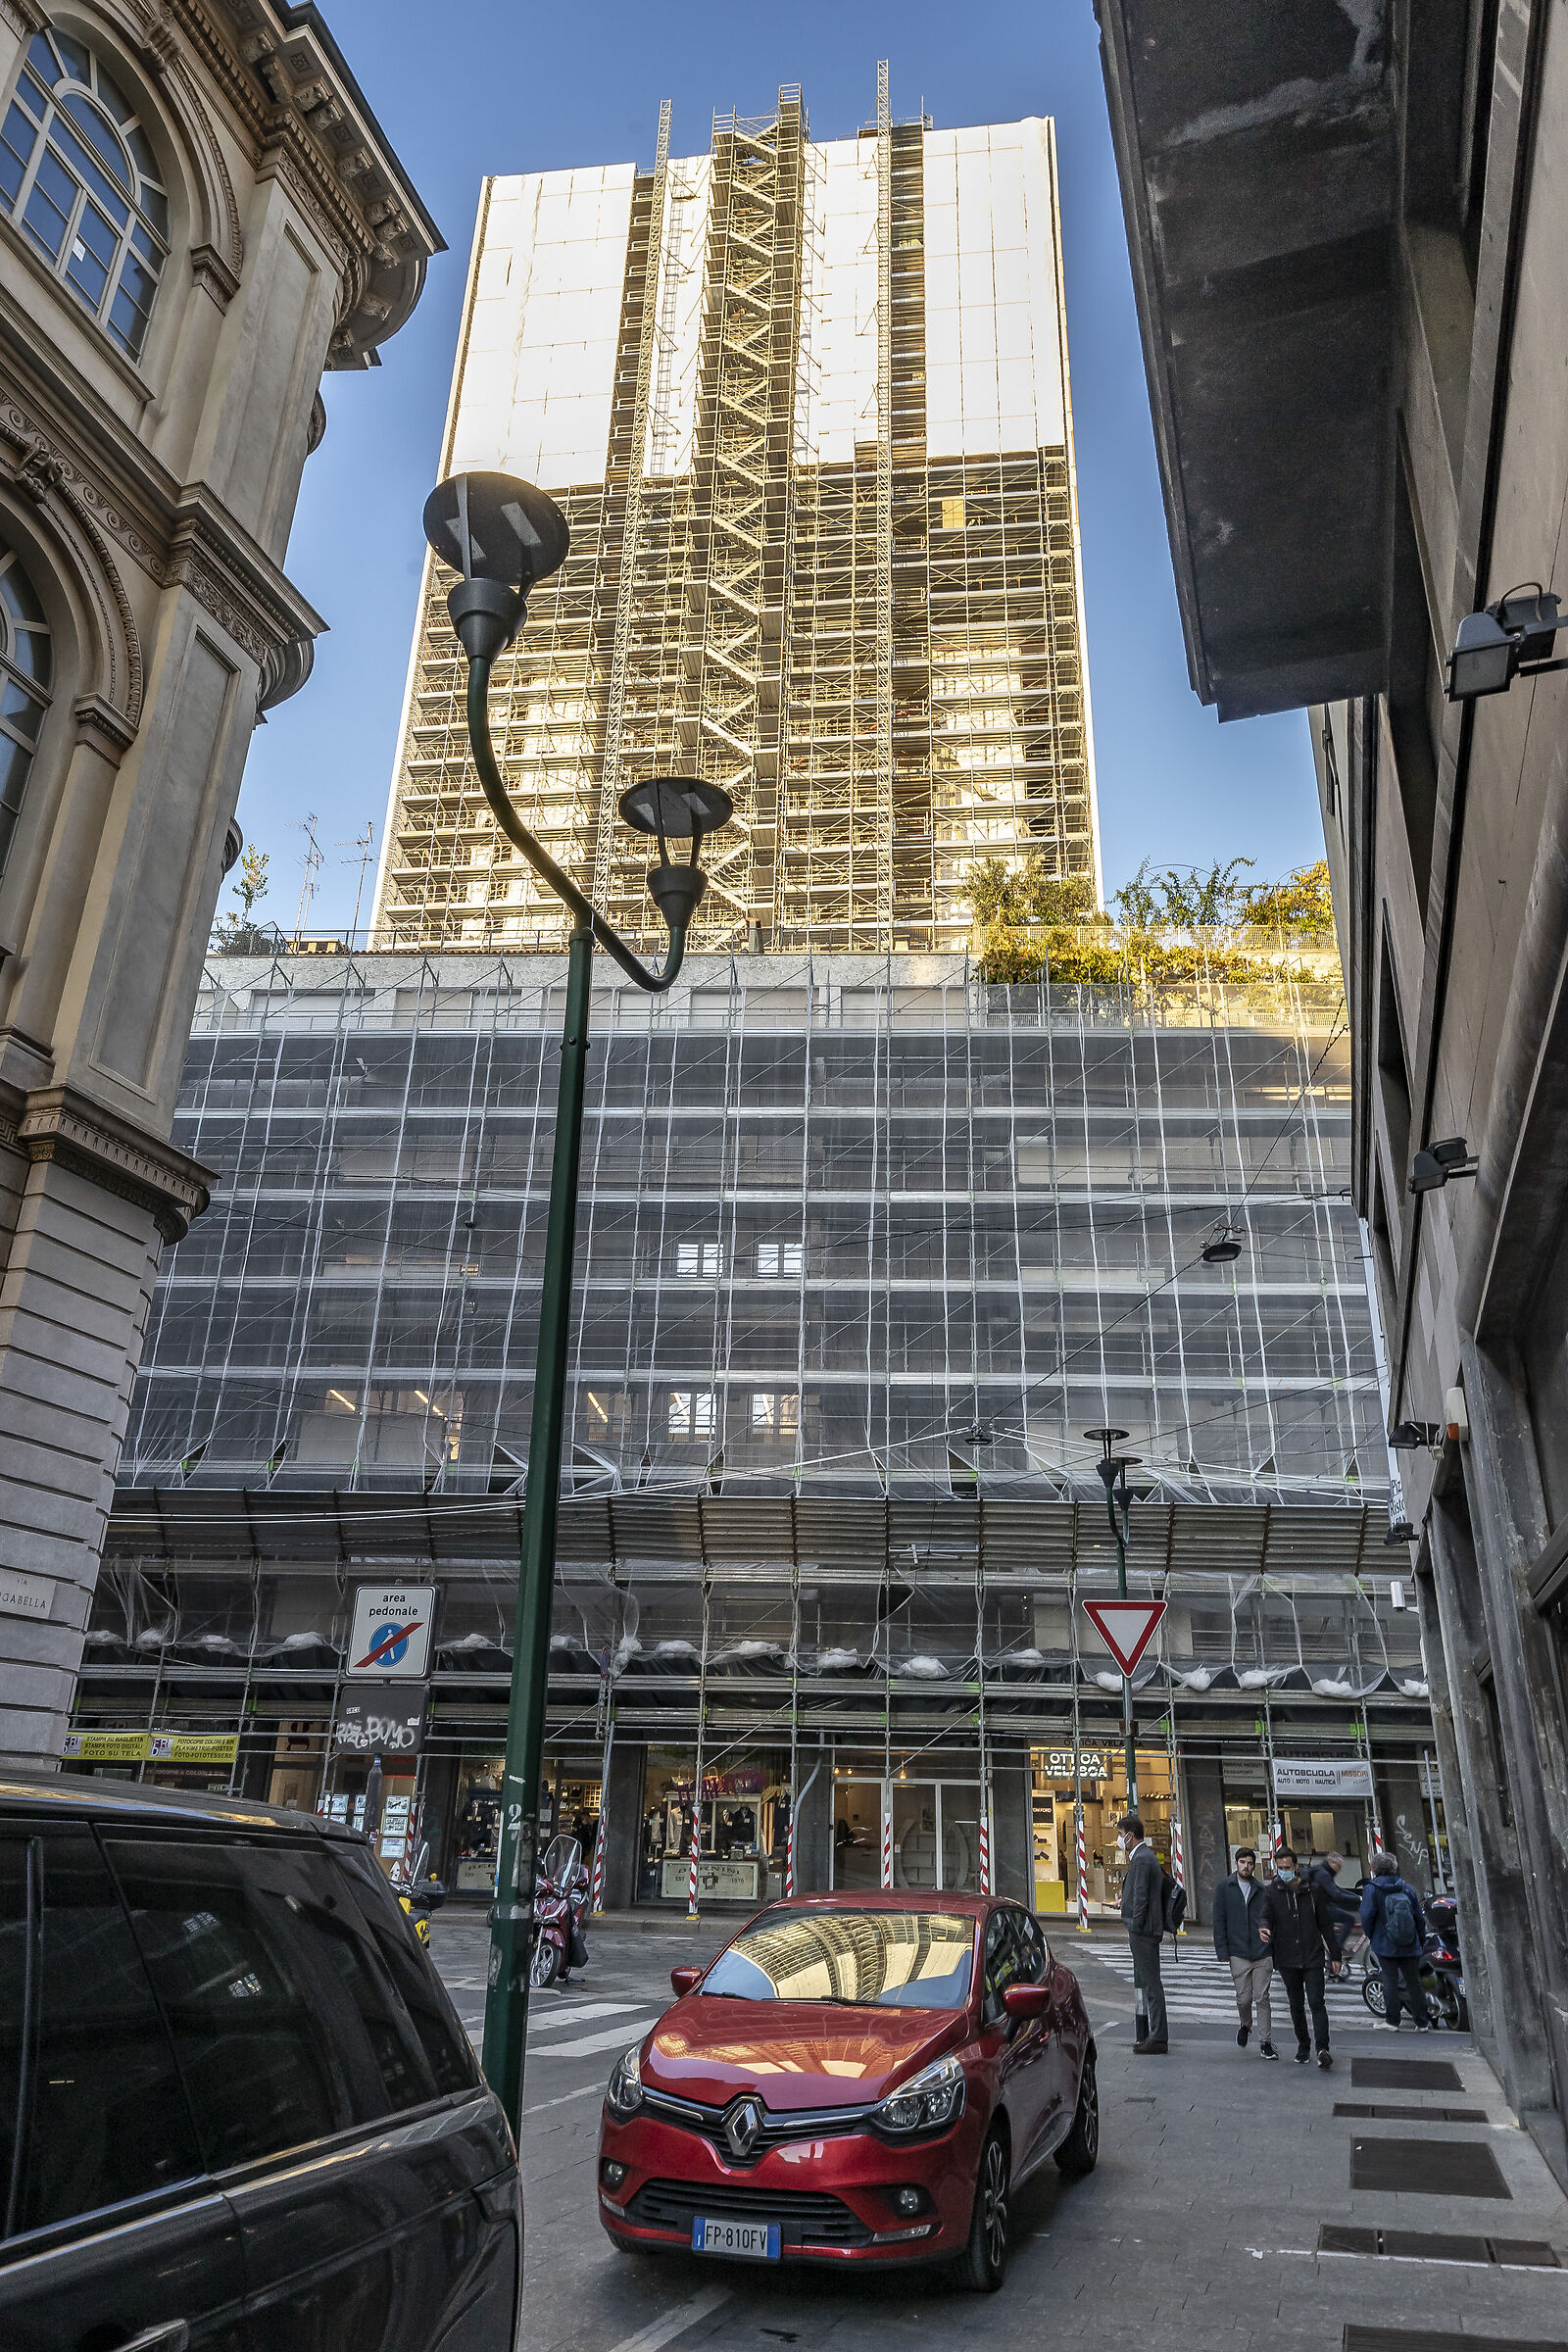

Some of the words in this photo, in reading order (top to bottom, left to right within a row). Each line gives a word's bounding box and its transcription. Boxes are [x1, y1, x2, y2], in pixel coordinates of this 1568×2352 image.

[17, 1577, 27, 1586] VIA
[0, 1592, 47, 1609] GABELLA
[382, 1594, 406, 1603] area
[368, 1606, 418, 1618] pedonale
[1050, 1753, 1101, 1765] OTTCA
[1276, 1768, 1336, 1777] AUTOSCUOLA
[508, 1803, 522, 1831] 2
[678, 1865, 741, 1876] BRNINI
